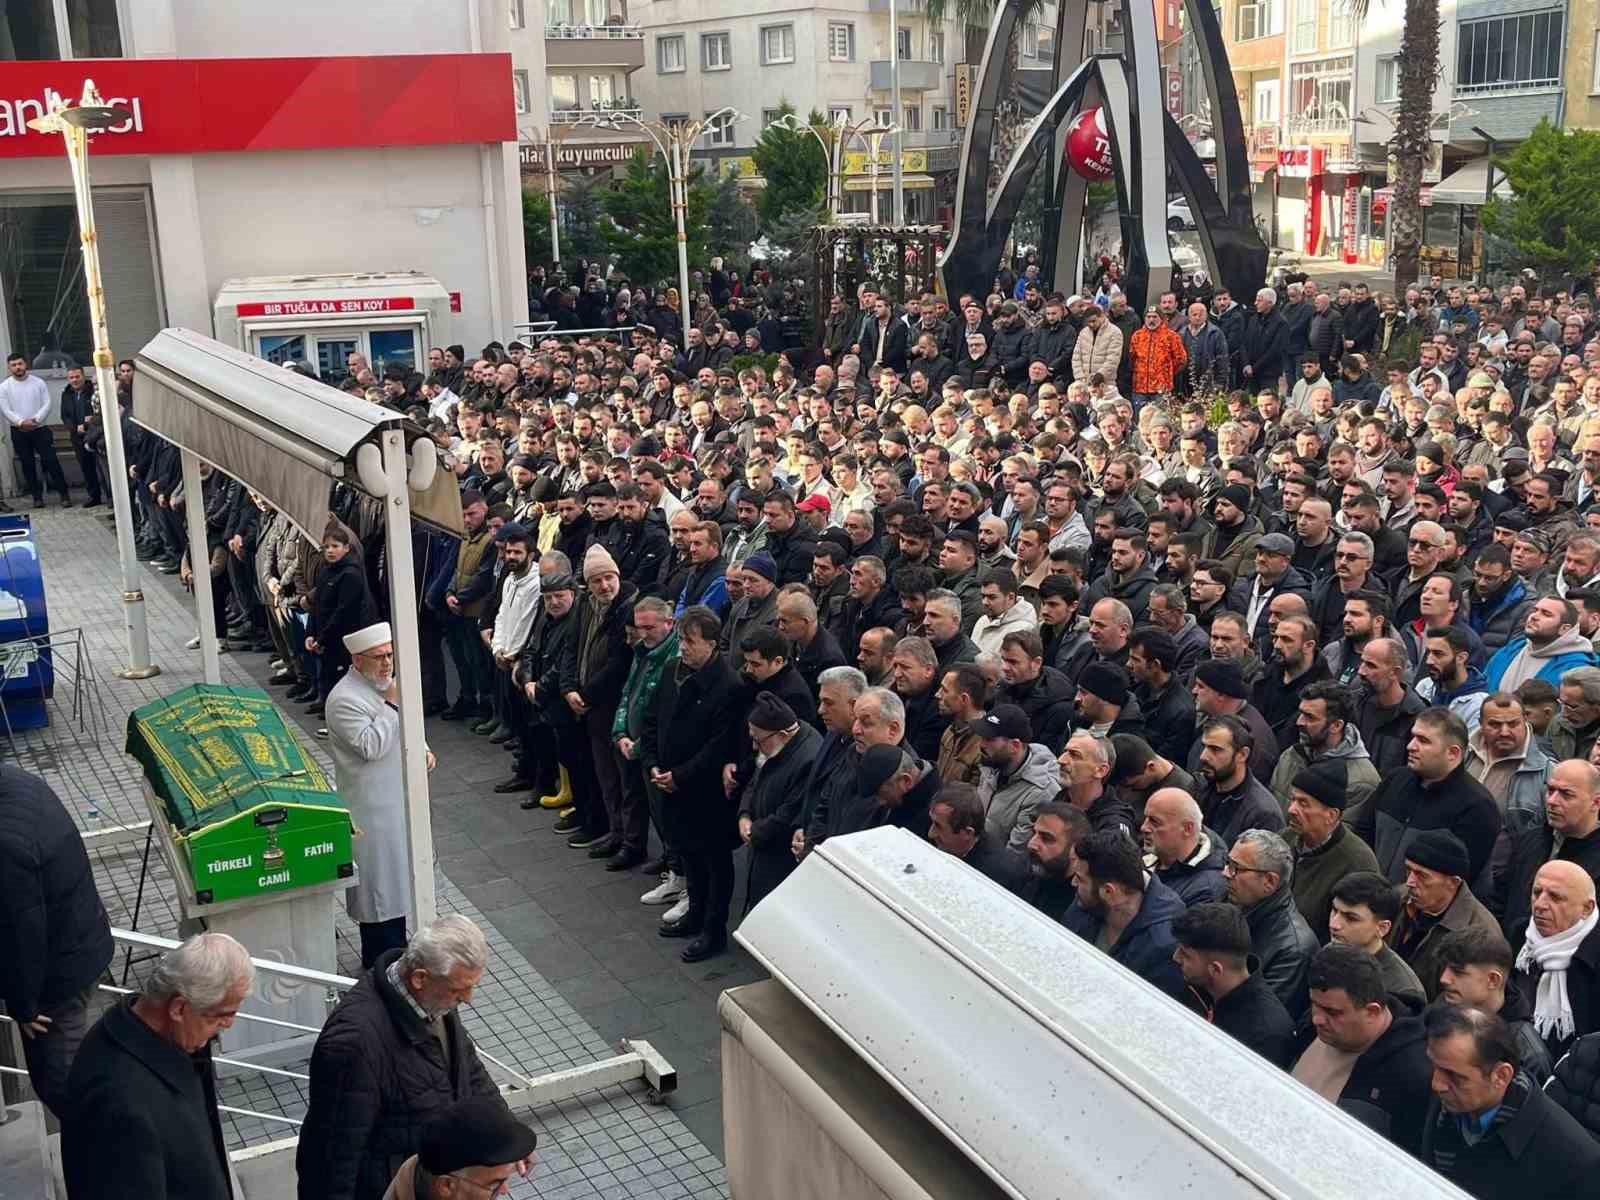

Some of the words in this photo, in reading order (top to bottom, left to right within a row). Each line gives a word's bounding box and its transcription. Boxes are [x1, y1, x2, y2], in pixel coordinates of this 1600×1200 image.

[556, 144, 636, 167] kuyumculu
[284, 301, 319, 314] TUĞLA
[321, 302, 336, 313] DA
[340, 300, 361, 312] SEN
[363, 300, 384, 311] KOY
[207, 855, 253, 874] TÜRKELİ
[304, 842, 334, 858] FATİH
[258, 870, 290, 887] CAMİİ
